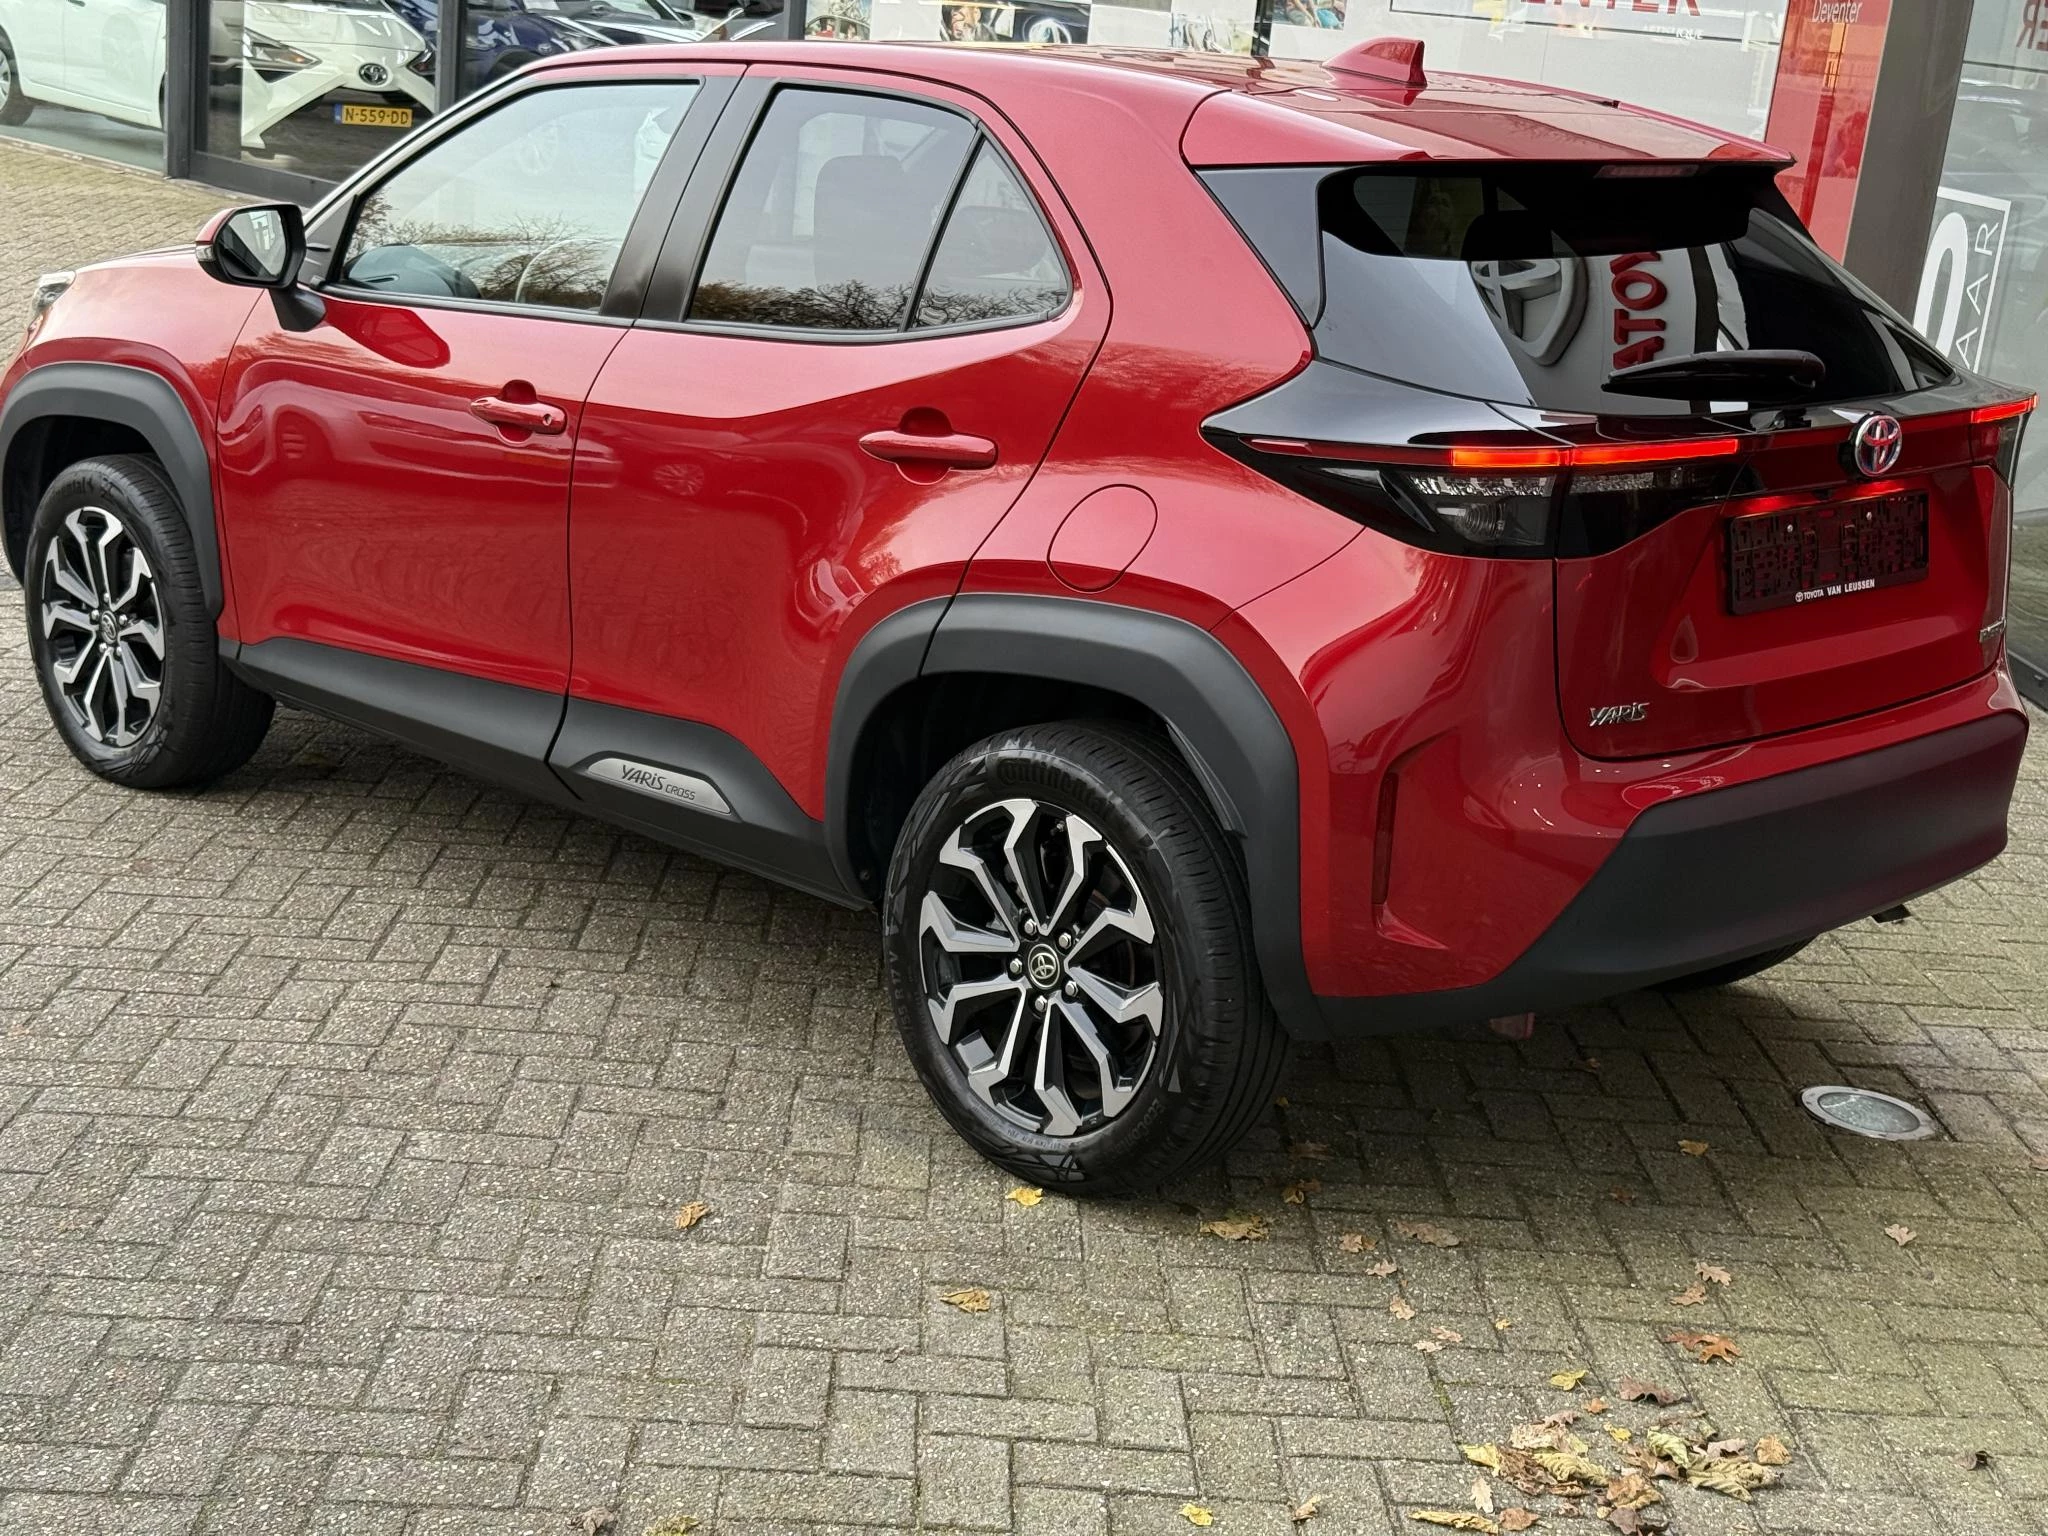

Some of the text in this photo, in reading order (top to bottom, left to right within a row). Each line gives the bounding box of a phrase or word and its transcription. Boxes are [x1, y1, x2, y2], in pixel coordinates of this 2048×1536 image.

[1811, 0, 1863, 23] Deventer
[345, 107, 409, 124] N-559-DD
[1804, 579, 1875, 600] TOYOTA VAN LEUSSEN
[665, 784, 695, 801] CROSS
